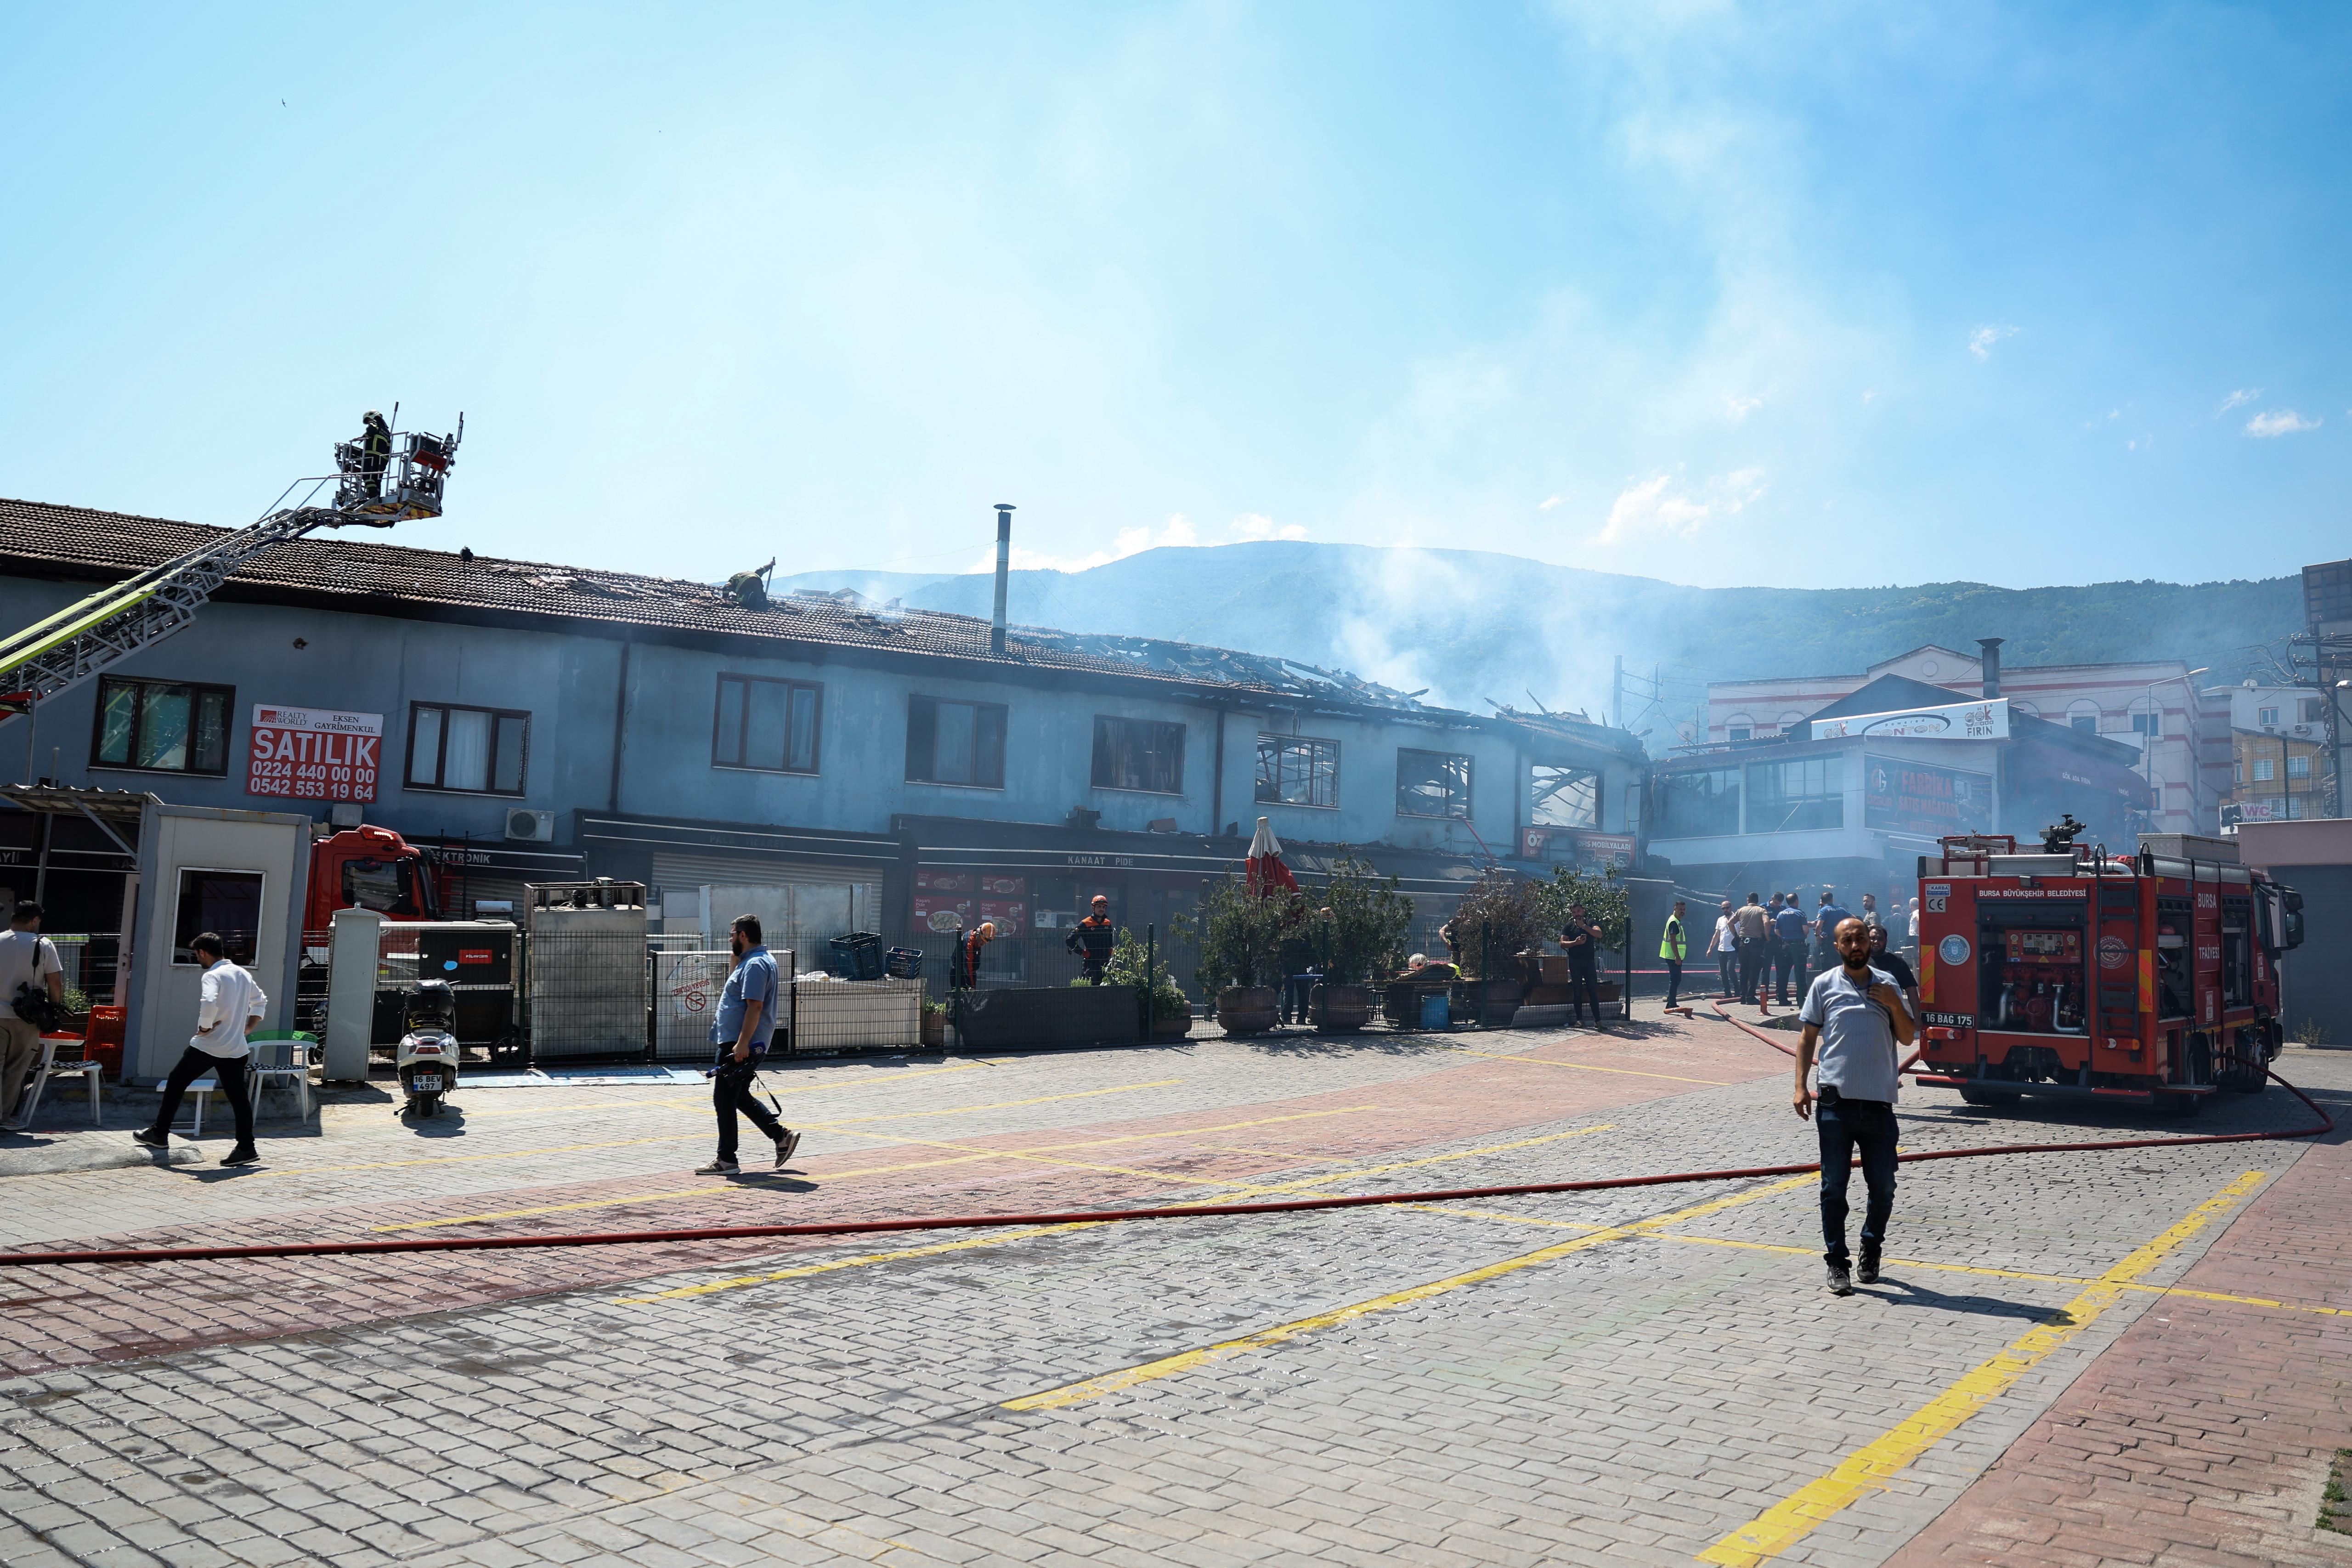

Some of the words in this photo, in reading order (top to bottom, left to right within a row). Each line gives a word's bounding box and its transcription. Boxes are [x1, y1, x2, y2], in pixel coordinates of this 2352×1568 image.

[277, 711, 307, 720] REALTY
[277, 718, 306, 726] WORLD
[315, 722, 375, 733] GAYRİMENKUL
[1885, 719, 1925, 727] powered
[1968, 726, 1992, 737] FIRIN
[254, 730, 377, 767] SATILIK
[252, 761, 292, 777] 0224
[296, 764, 326, 780] 440
[331, 766, 351, 782] 00
[356, 768, 374, 784] 00
[250, 777, 290, 794] 0542
[295, 781, 324, 797] 553
[331, 783, 349, 798] 19
[354, 785, 373, 801] 64
[2244, 806, 2270, 816] WC
[1591, 839, 1631, 850] MOBİLYALARI
[1068, 856, 1105, 865] KANAAT
[2003, 889, 2044, 898] BÜYÜKŞEHİR
[2047, 889, 2086, 897] BELEDİYESİ
[1928, 899, 1944, 911] CE
[2198, 893, 2217, 908] BURSA
[1926, 1013, 1935, 1023] 16
[1938, 1014, 1954, 1024] BAG
[1957, 1016, 1972, 1025] 175
